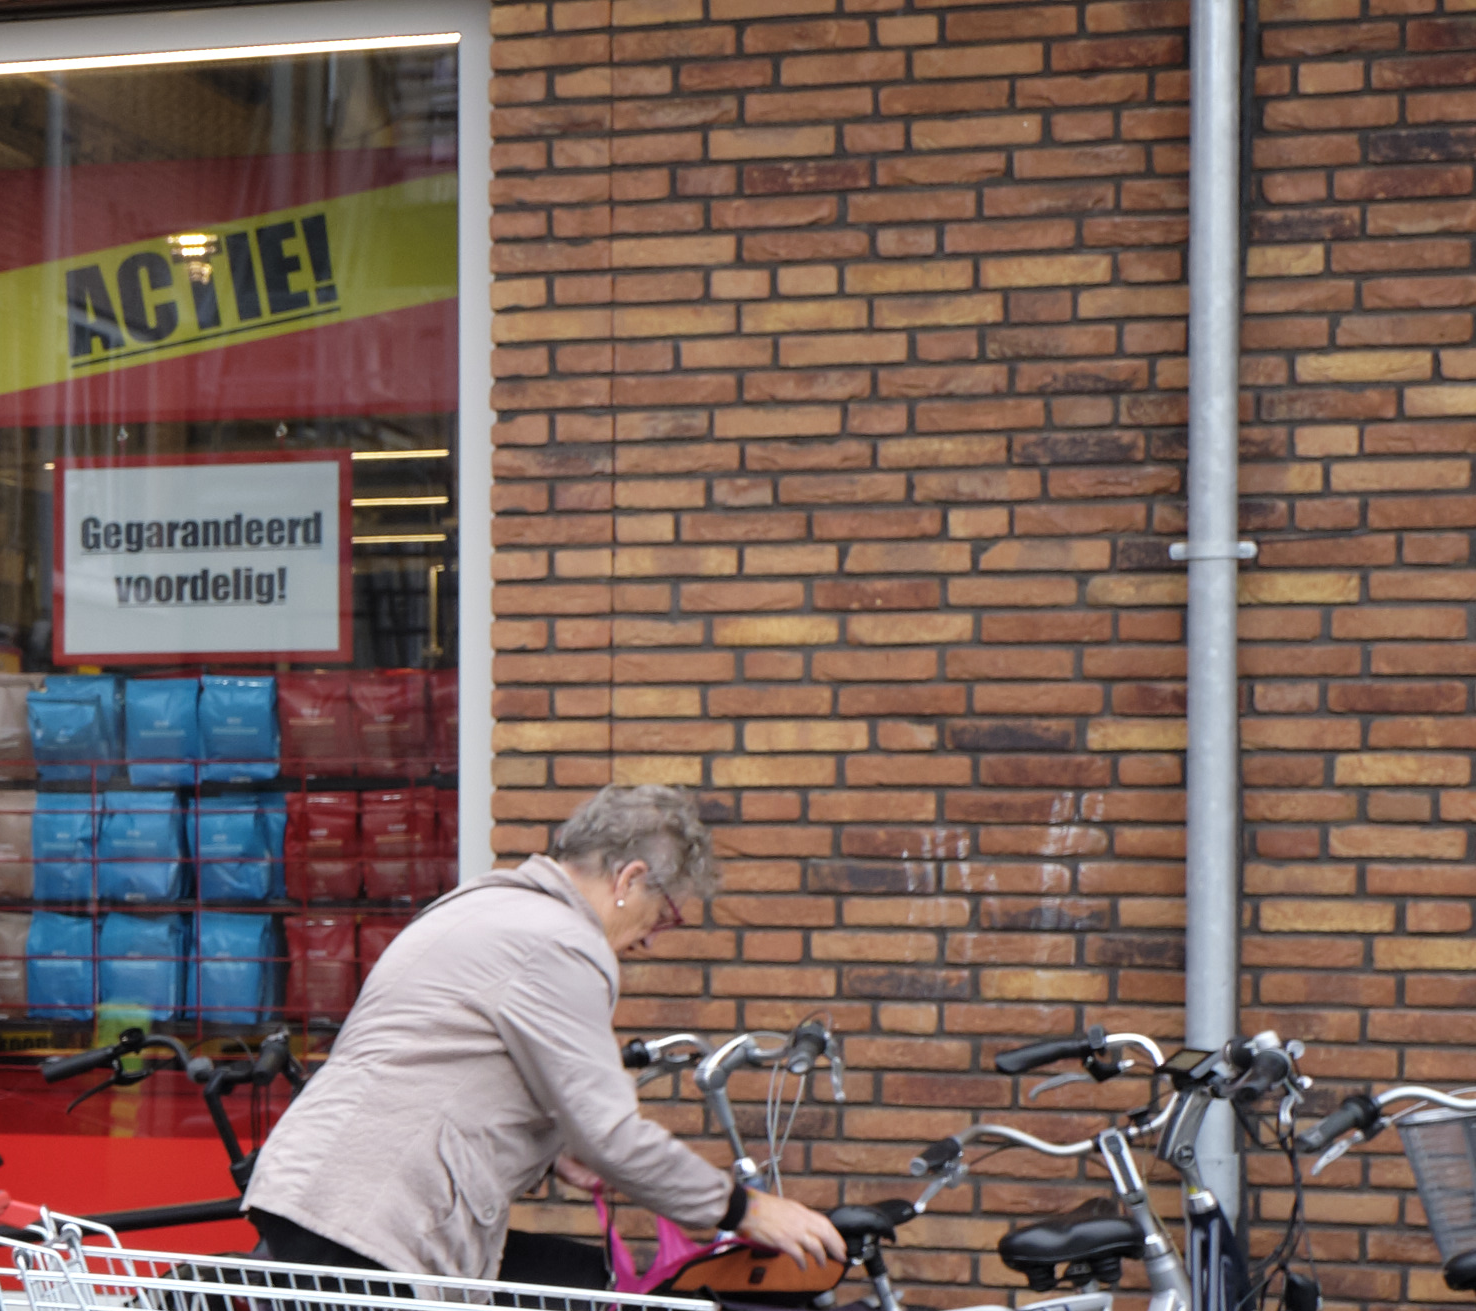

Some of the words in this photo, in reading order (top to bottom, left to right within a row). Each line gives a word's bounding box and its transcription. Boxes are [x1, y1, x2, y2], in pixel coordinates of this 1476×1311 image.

[66, 212, 339, 358] ACTIE!
[80, 510, 323, 553] Gegarandeerd
[114, 566, 288, 605] voordelig!
